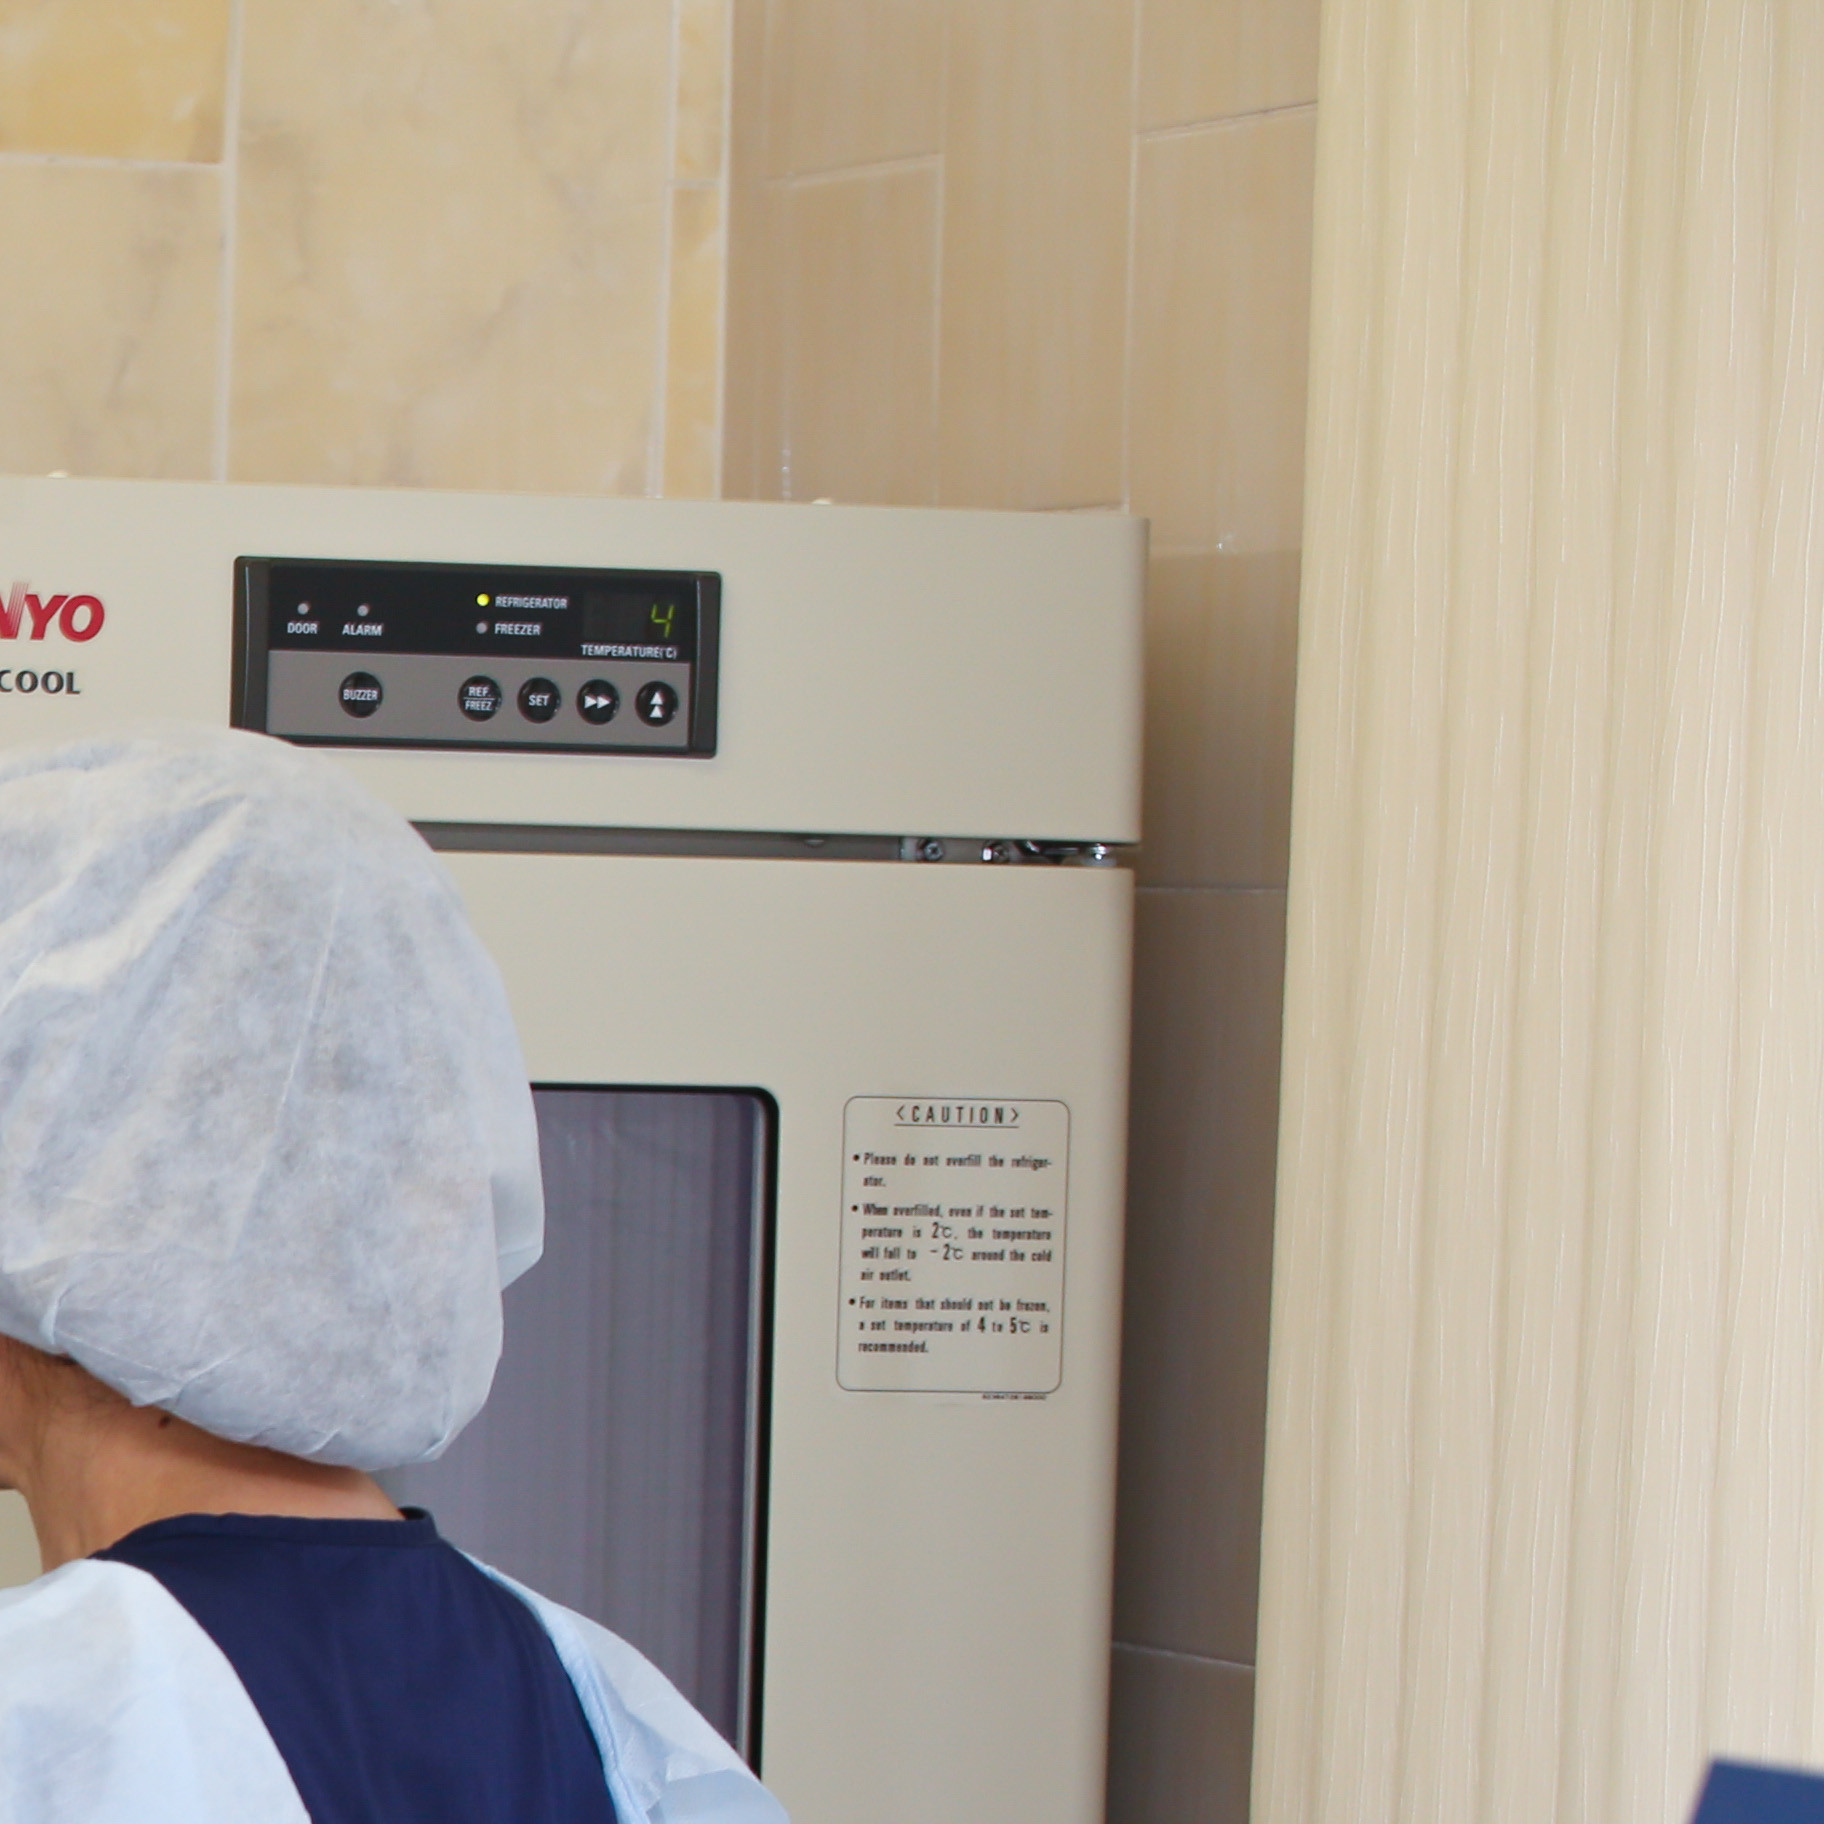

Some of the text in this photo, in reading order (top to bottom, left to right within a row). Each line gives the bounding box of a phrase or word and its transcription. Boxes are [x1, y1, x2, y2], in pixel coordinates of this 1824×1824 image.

[495, 596, 568, 609] REFRIGERATOR
[651, 604, 674, 638] 4
[287, 622, 318, 634] DOOR
[342, 624, 382, 636] ALARM
[495, 623, 541, 635] FREEZER
[343, 689, 378, 700] BUZZER
[529, 695, 549, 706] SET
[864, 1152, 896, 1165] Please
[904, 1154, 915, 1165] do
[989, 1155, 1003, 1167] the
[863, 1203, 887, 1215] When
[989, 1206, 1004, 1218] the
[1010, 1207, 1025, 1218] set
[968, 1227, 983, 1239] the
[884, 1247, 900, 1259] fall
[1010, 1250, 1024, 1261] the
[859, 1296, 875, 1309] For
[881, 1297, 907, 1309] items
[915, 1298, 935, 1310] that
[940, 1298, 972, 1311] should
[871, 1320, 886, 1331] set
[978, 1317, 985, 1333] 4
[992, 1322, 1002, 1332] to
